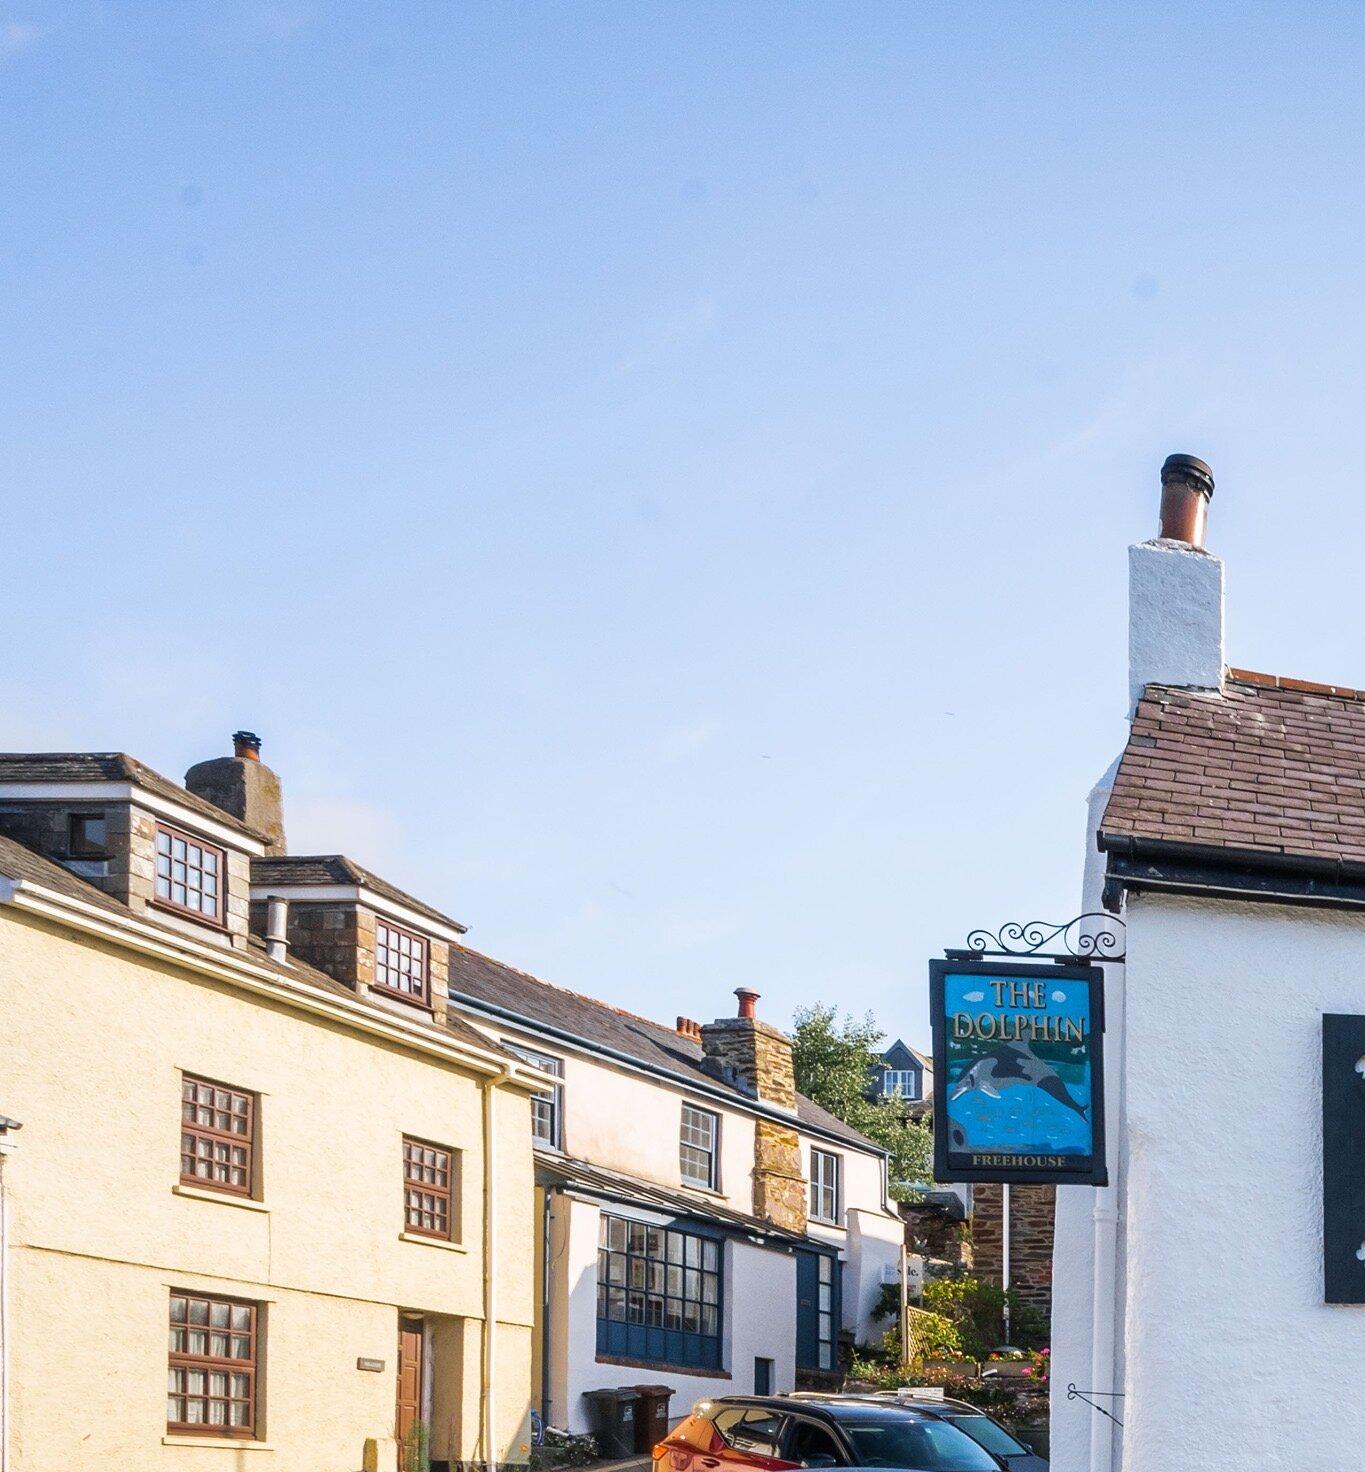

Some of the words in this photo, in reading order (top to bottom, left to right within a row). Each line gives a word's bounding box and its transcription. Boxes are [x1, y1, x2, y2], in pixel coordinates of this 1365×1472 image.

[990, 980, 1047, 1009] THE
[952, 1012, 1086, 1043] DOLPHIN
[971, 1154, 1067, 1168] FREEHOUSE
